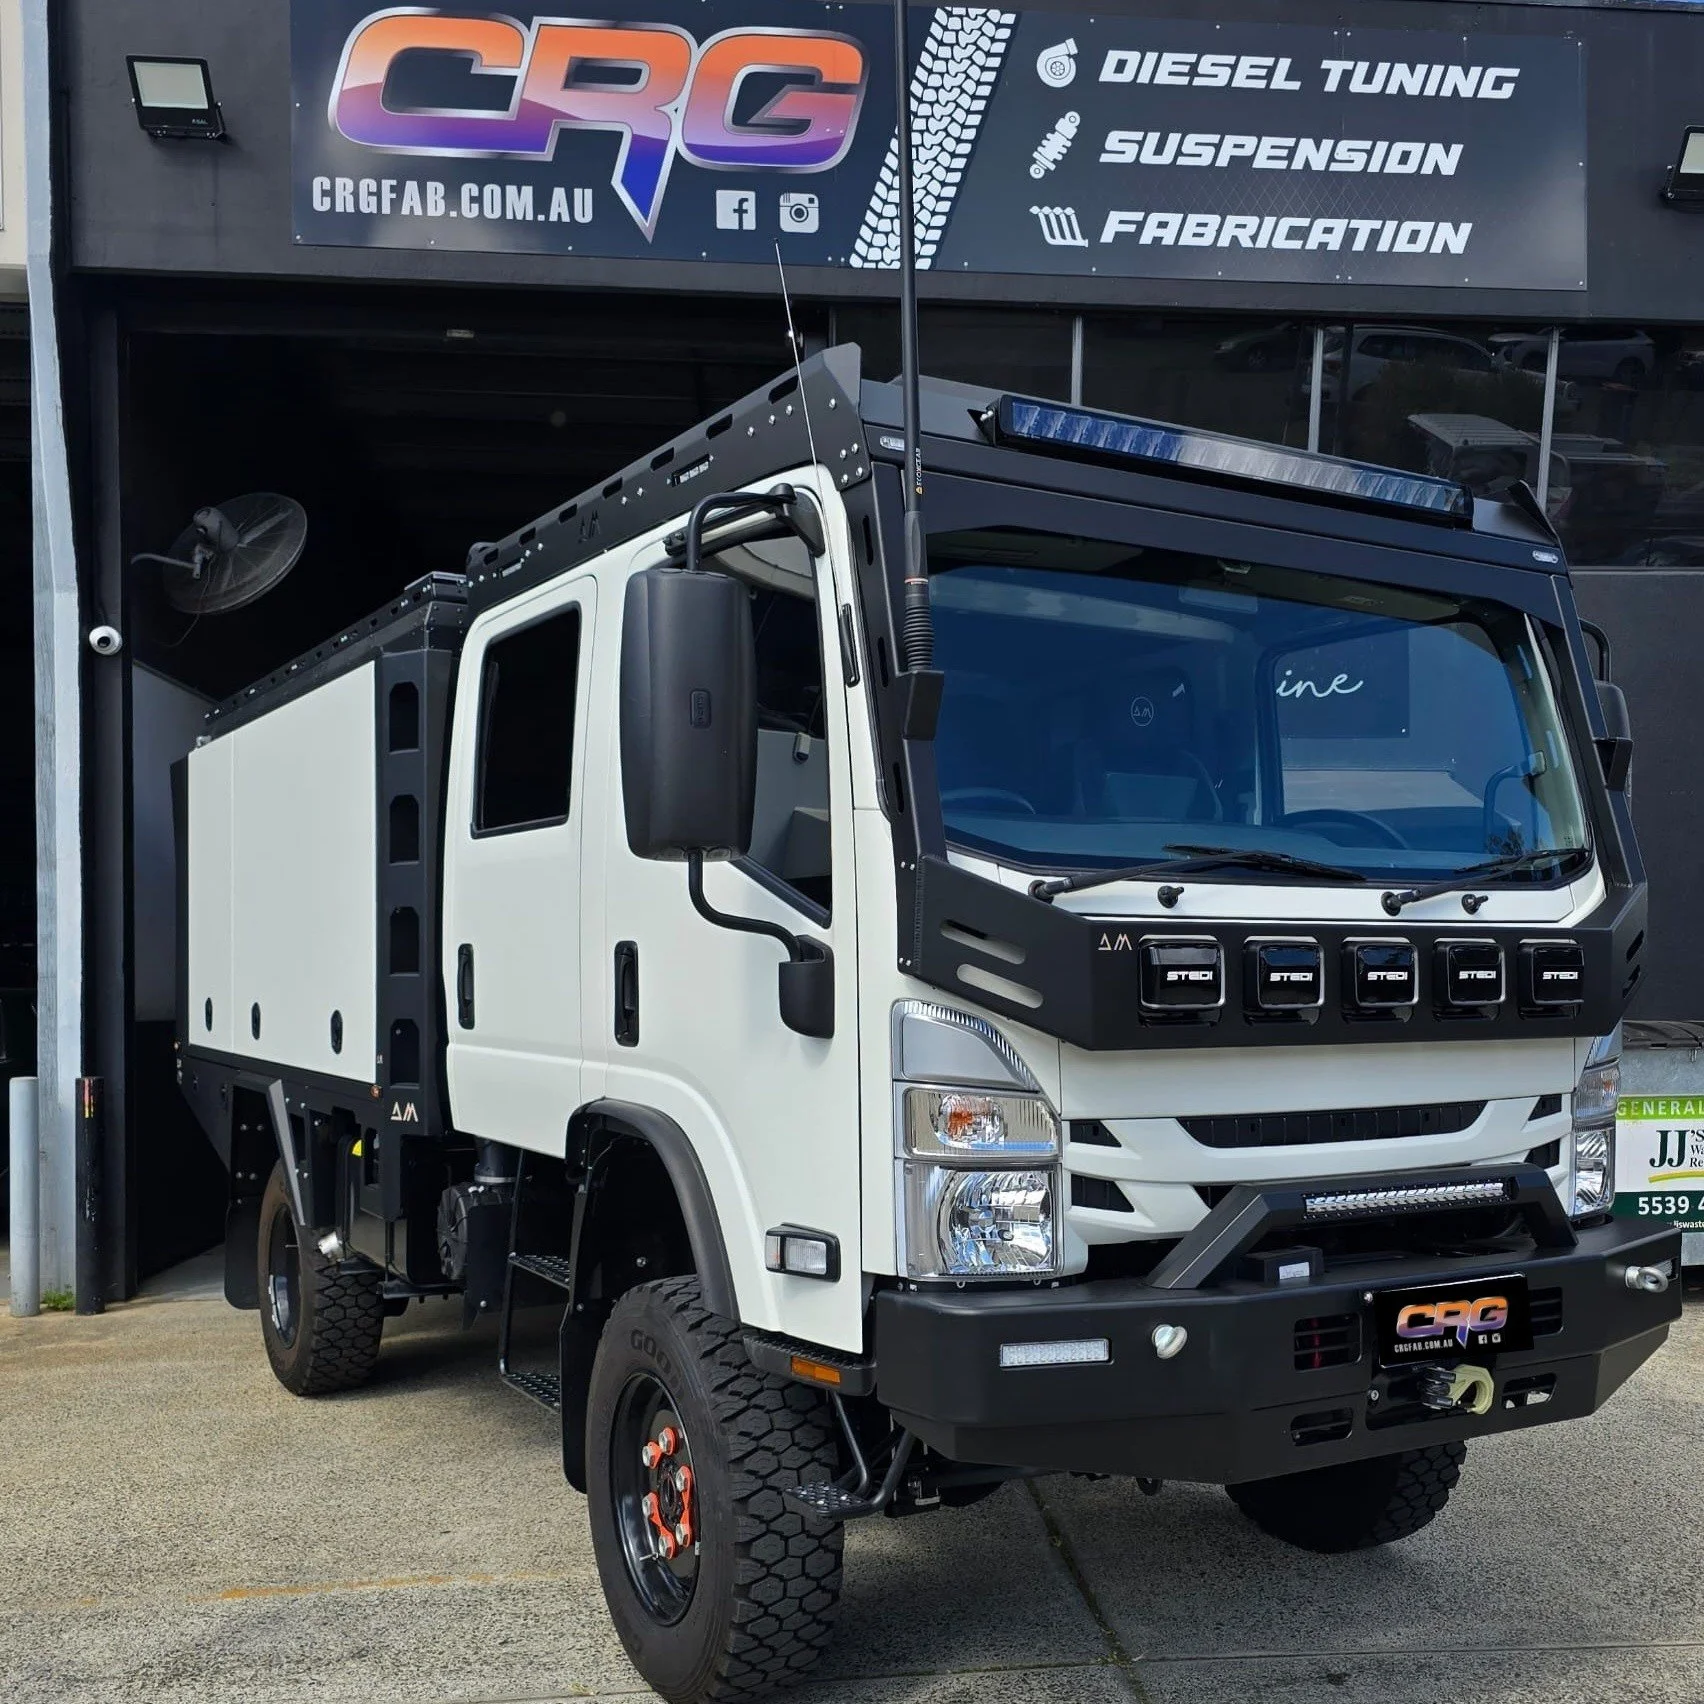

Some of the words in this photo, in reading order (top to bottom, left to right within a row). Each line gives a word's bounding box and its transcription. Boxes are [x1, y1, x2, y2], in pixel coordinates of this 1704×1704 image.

[1099, 50, 1301, 90] DIESEL
[1320, 60, 1520, 99] TUNING
[328, 6, 869, 243] CRG
[1099, 130, 1464, 175] SUSPENSION
[312, 176, 593, 224] CRGFAB.COM.AU
[1100, 210, 1472, 254] FABRICATION
[1166, 970, 1213, 981] STEDI
[1269, 972, 1313, 982] STEDI
[1367, 971, 1408, 981] STEDI
[1458, 970, 1497, 980] STEDI
[1542, 971, 1579, 980] STEDI
[1617, 1100, 1704, 1116] GENERAL
[1638, 1196, 1689, 1215] 5539
[1396, 1296, 1508, 1349] CRG
[1394, 1339, 1453, 1353] CRGFAB.COM.AU
